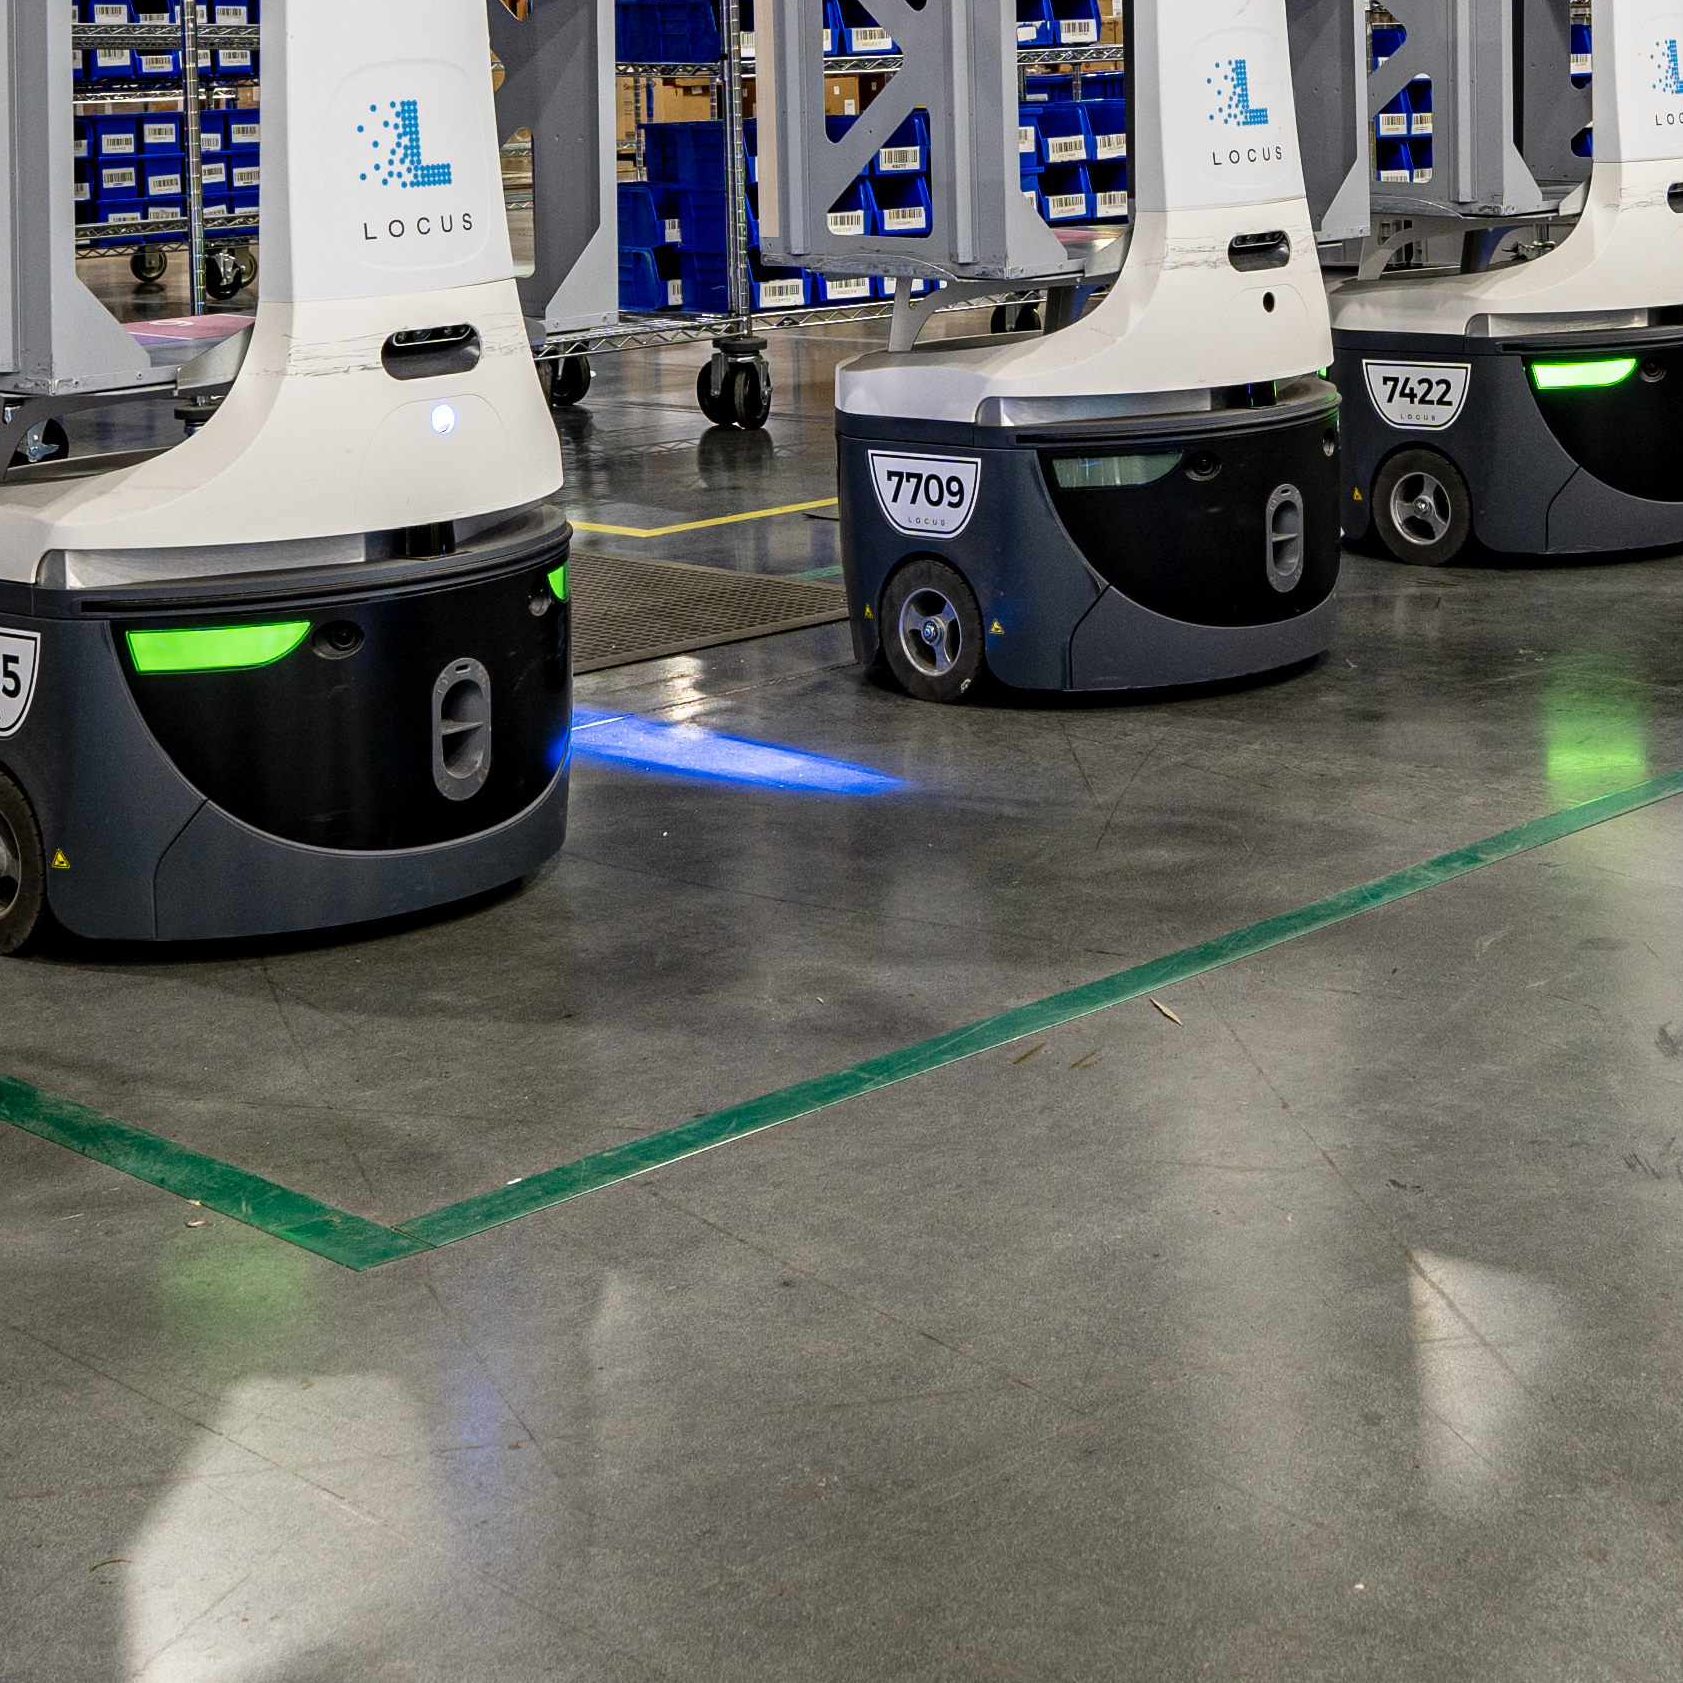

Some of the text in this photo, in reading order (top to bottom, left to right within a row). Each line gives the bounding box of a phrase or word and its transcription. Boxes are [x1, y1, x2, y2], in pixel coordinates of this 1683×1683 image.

[1212, 145, 1282, 166] LOCUS
[363, 212, 473, 240] LOCUS
[1382, 376, 1453, 407] 7422
[1400, 413, 1436, 422] LOCUS
[886, 470, 964, 509] 7709
[908, 516, 946, 527] LOCUS
